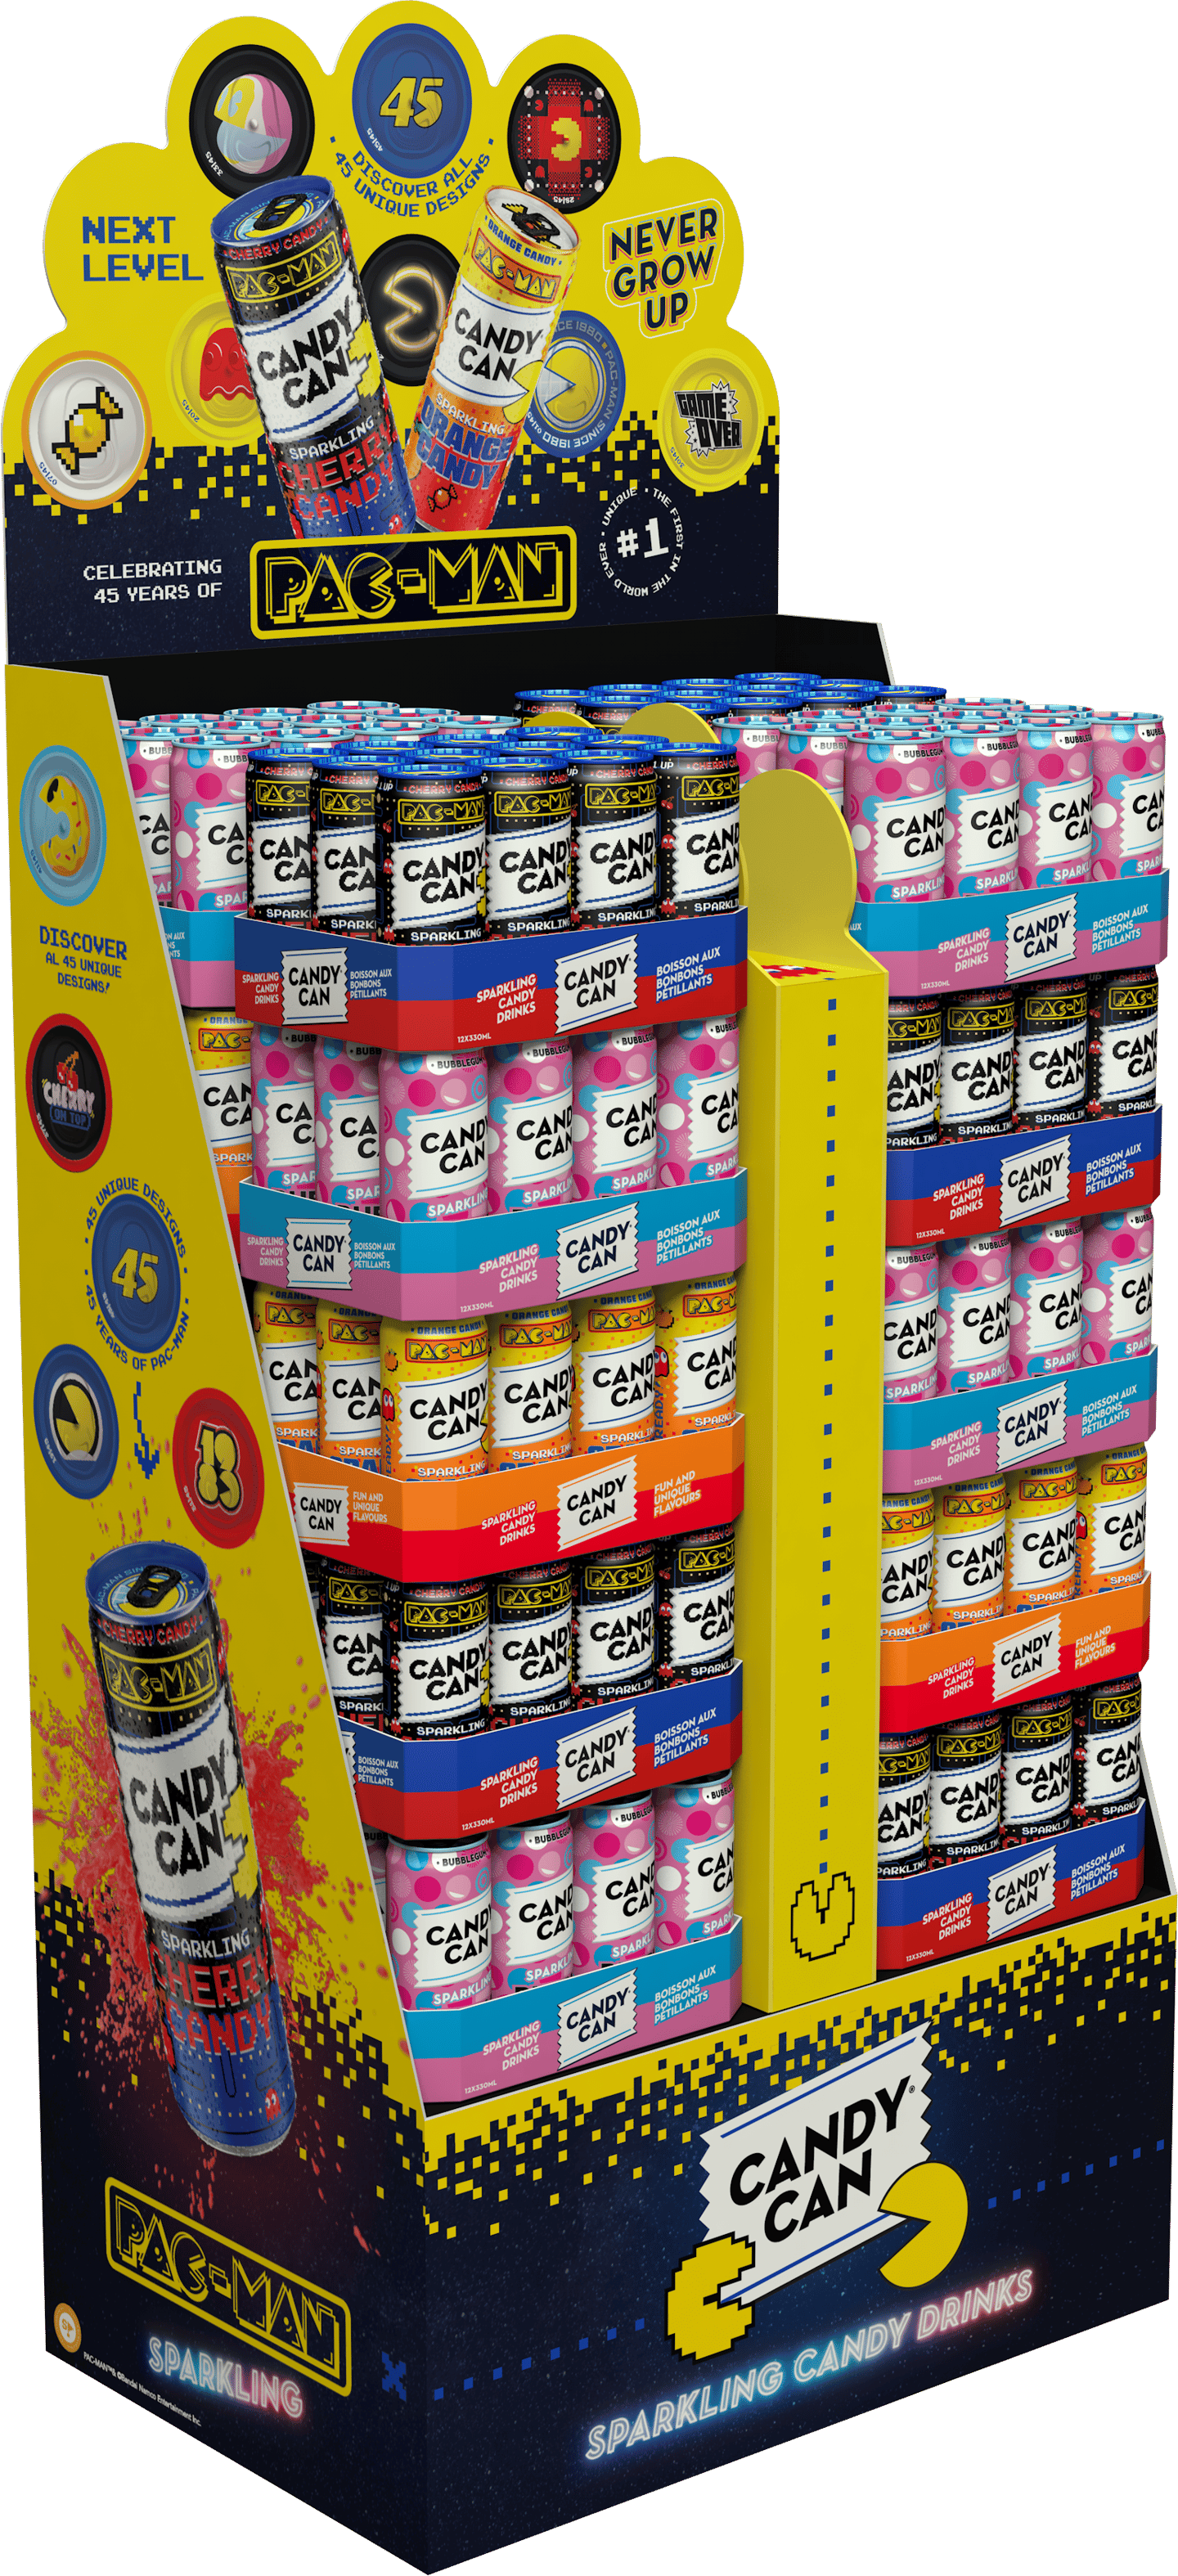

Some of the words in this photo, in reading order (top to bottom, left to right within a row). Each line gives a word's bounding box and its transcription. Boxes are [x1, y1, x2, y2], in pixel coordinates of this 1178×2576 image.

[380, 77, 443, 128] 45
[335, 152, 353, 178] 45
[354, 178, 420, 217] UNIQUE
[426, 154, 490, 215] DESIGNS
[353, 151, 438, 198] DISCOVER
[443, 157, 473, 187] ALL
[83, 216, 176, 244] NEXT
[229, 241, 281, 260] CHERRY
[283, 219, 322, 250] CANDY
[488, 218, 522, 253] ORANGE
[524, 247, 556, 267] CANDY
[609, 206, 719, 263] NEVER
[83, 255, 204, 281] LEVEL
[230, 240, 336, 298] PAC-MAN
[474, 235, 555, 299] PAC-MAN
[612, 245, 715, 299] GROW
[645, 290, 690, 330] UP
[257, 295, 352, 380] CANDY
[455, 308, 543, 354] CANDY
[576, 321, 603, 343] 1980
[283, 347, 348, 408] CAN
[458, 345, 516, 382] CAN
[605, 351, 618, 420] PAC-MAN
[435, 393, 506, 435] SPARKLING
[678, 393, 726, 419] GAME
[289, 416, 375, 460] SPARKLING
[420, 394, 514, 463] ORANGE
[543, 431, 570, 448] 1980
[573, 420, 605, 448] SINCE
[696, 419, 741, 448] OVER
[278, 422, 393, 491] CHERRY
[416, 430, 501, 490] CANDY
[294, 453, 394, 519] CANDY
[654, 488, 672, 508] THE
[602, 487, 637, 526] UNIQUE
[670, 507, 684, 550] FIRST
[83, 560, 222, 581] CELEBRATING
[599, 542, 614, 578] EVER
[669, 554, 681, 572] IN
[94, 587, 119, 604] 45
[128, 584, 190, 602] YEARS
[197, 582, 223, 597] OF
[265, 542, 564, 624] PAC-MAN
[614, 578, 649, 596] WORLD
[651, 573, 671, 593] THE
[40, 925, 127, 960] DISCOVER
[1014, 910, 1070, 943] CANDY
[656, 955, 699, 977] BOISSON
[700, 947, 721, 961] AUX
[1023, 933, 1058, 958] CAN
[46, 952, 59, 965] AL
[63, 955, 76, 969] 45
[80, 958, 122, 978] UNIQUE
[564, 954, 629, 991] CANDY
[656, 965, 704, 991] BONBONS
[57, 973, 110, 994] DESIGNS!
[476, 974, 537, 1003] SPARKLING
[498, 990, 536, 1009] CANDY
[576, 980, 615, 1008] CAN
[497, 1002, 536, 1024] DRINKS
[55, 1108, 66, 1122] ON
[70, 1112, 86, 1126] TOP
[1008, 1153, 1063, 1188] CANDY
[1086, 1152, 1124, 1172] BOISSON
[1126, 1144, 1141, 1158] AUX
[1086, 1160, 1127, 1184] BONBONS
[933, 1174, 984, 1202] SPARKLING
[951, 1185, 983, 1206] CANDY
[1018, 1176, 1052, 1203] CAN
[86, 1207, 97, 1230] 45
[96, 1177, 139, 1207] UNIQUE
[142, 1183, 187, 1258] DESIGNS
[950, 1200, 983, 1221] DRINKS
[565, 1221, 630, 1258] CANDY
[111, 1248, 159, 1304] 45
[578, 1248, 618, 1275] CAN
[86, 1284, 97, 1310] 45
[96, 1315, 128, 1364] YEARS
[133, 1356, 146, 1371] OF
[151, 1310, 189, 1371] PAC-MAN
[417, 1326, 456, 1335] ORANGE
[458, 1324, 481, 1333] CANDY
[408, 1337, 488, 1360] PAC-MAN
[410, 1387, 488, 1420] CANDY
[1005, 1398, 1060, 1433] CANDY
[428, 1415, 481, 1441] CAN
[1014, 1421, 1049, 1447] CAN
[417, 1460, 486, 1477] SPARKLING
[654, 1478, 673, 1495] FUN
[676, 1471, 695, 1486] AND
[567, 1475, 627, 1511] CANDY
[654, 1485, 691, 1506] UNIQUE
[654, 1490, 701, 1518] FLAVOURS
[481, 1500, 537, 1531] SPARKLING
[501, 1513, 536, 1534] CANDY
[579, 1499, 615, 1526] CAN
[500, 1523, 535, 1546] DRINKS
[103, 1618, 153, 1646] CHERRY
[156, 1616, 197, 1645] CANDY
[409, 1636, 488, 1679] CANDY
[1000, 1631, 1053, 1666] CANDY
[104, 1650, 214, 1704] PAC-MAN
[1011, 1654, 1042, 1679] CAN
[425, 1670, 479, 1701] CAN
[417, 1718, 485, 1736] SPARKLING
[565, 1726, 628, 1767] CANDY
[130, 1738, 227, 1827] CANDY
[577, 1752, 615, 1783] CAN
[155, 1809, 223, 1877] CAN
[995, 1863, 1049, 1903] CANDY
[1005, 1886, 1038, 1915] CAN
[161, 1928, 250, 1960] SPARKLING
[444, 1930, 488, 1963] CAN
[150, 1937, 269, 2008] CHERRY
[654, 1976, 696, 2002] BOISSON
[698, 1965, 716, 1984] AUX
[566, 1987, 628, 2029] CANDY
[654, 1985, 700, 2012] BONBONS
[167, 1994, 271, 2056] CANDY
[483, 2021, 540, 2056] SPARKLING
[579, 2012, 616, 2042] CAN
[502, 2046, 539, 2071] DRINKS
[504, 2031, 539, 2057] CANDY
[763, 2148, 872, 2243] CAN
[115, 2195, 339, 2379] PAC-MAN
[149, 2336, 303, 2419] SPARKLING
[586, 2362, 783, 2461] SPARKLING
[794, 2313, 910, 2383] CANDY
[917, 2270, 1033, 2340] DRINKS
[139, 2384, 156, 2400] Namco
[157, 2394, 191, 2421] Entertainment
